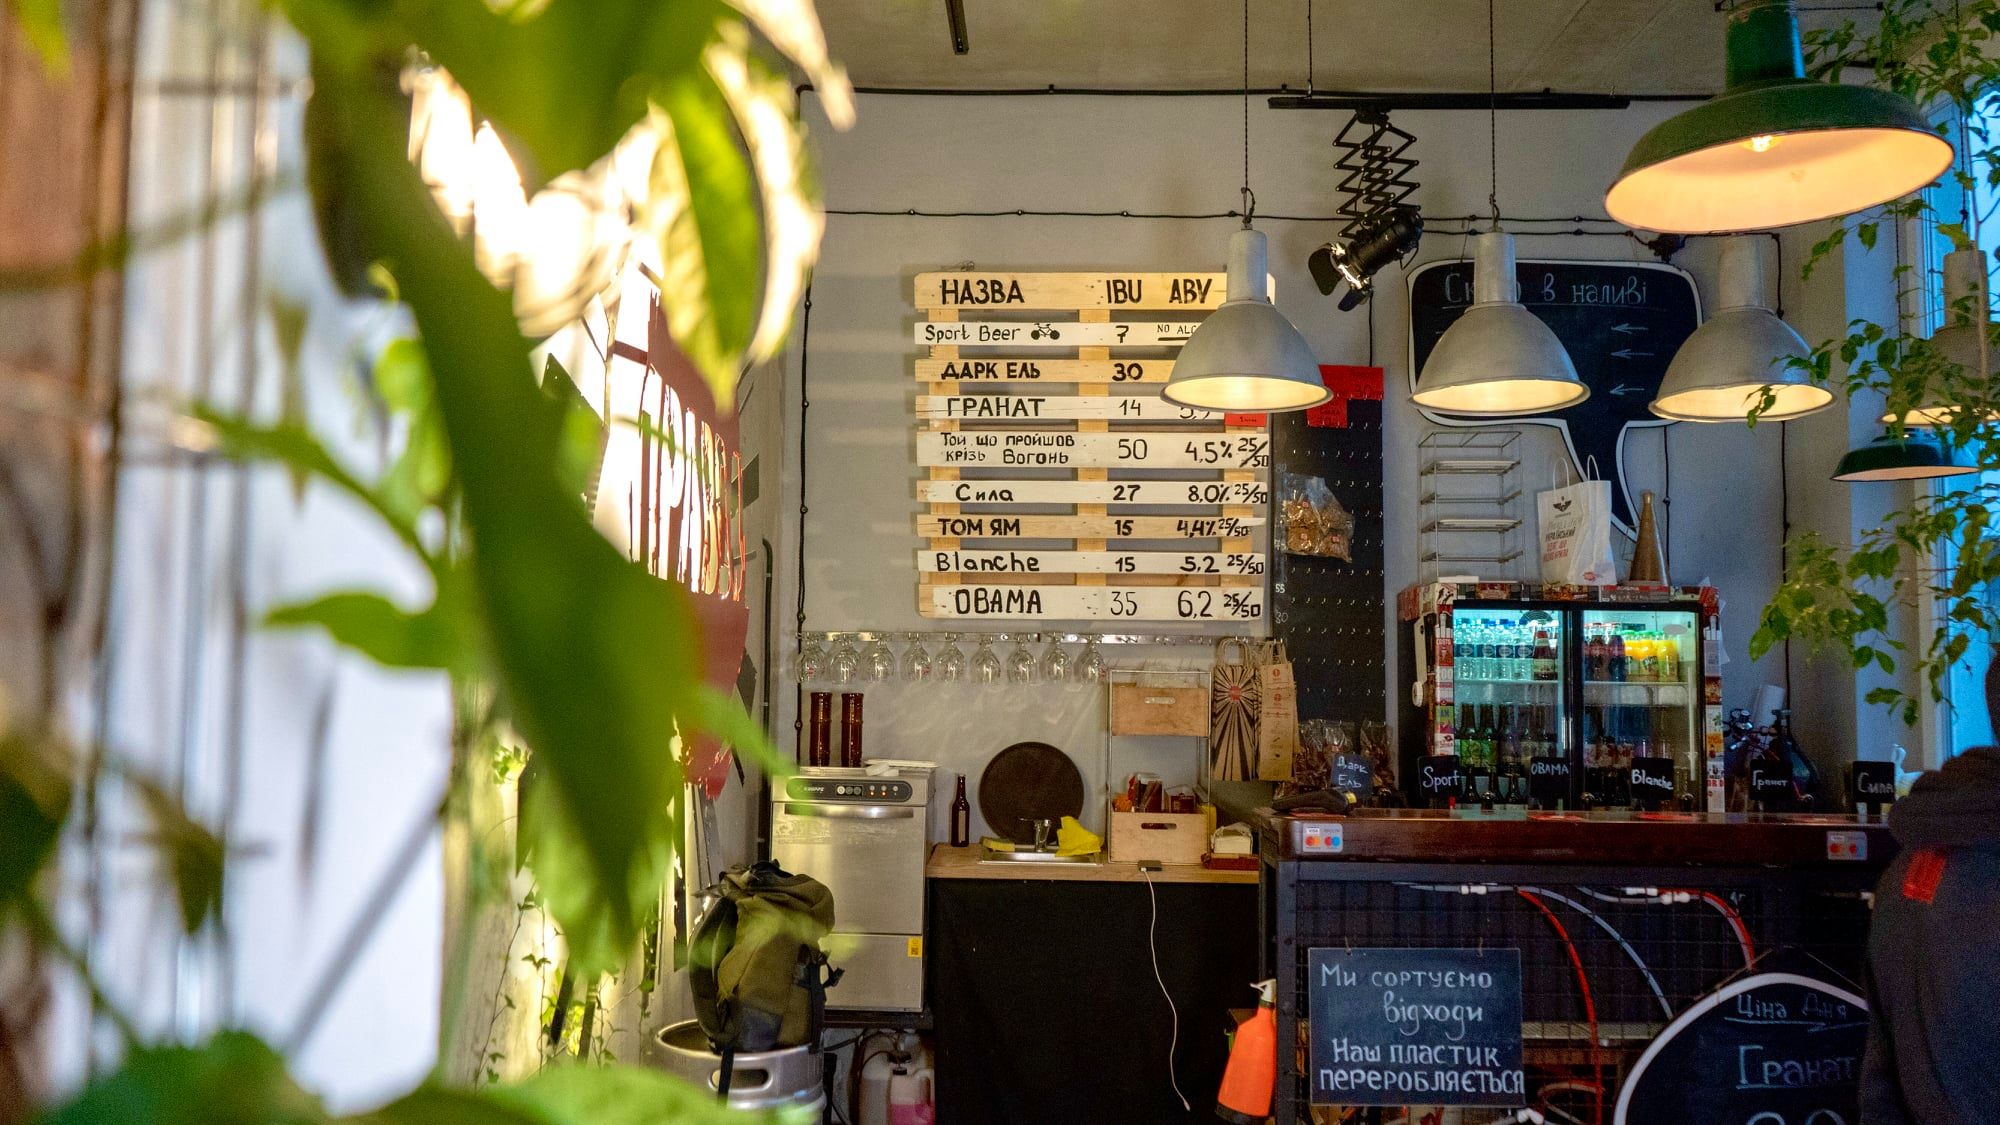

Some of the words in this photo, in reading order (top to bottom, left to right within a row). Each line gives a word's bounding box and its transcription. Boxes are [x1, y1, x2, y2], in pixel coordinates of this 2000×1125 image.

[941, 279, 1025, 305] НАЗВА
[1106, 279, 1142, 304] IBU
[1572, 275, 1647, 304] наливі
[925, 324, 969, 344] Sport
[979, 325, 1021, 342] Beer
[1116, 325, 1130, 344] 7
[1156, 324, 1170, 334] NO
[941, 361, 999, 380] ДАРК
[1006, 362, 1041, 379] ЕЛЬ
[1111, 362, 1143, 381] 30
[946, 397, 1046, 417] ГРАНАТ
[1118, 400, 1142, 416] 14
[1002, 449, 1069, 465] Вогонь
[1117, 439, 1148, 460] 50
[1185, 440, 1233, 464] 4,5%
[1237, 437, 1269, 468] 25/50
[955, 484, 1014, 502] Сила
[1113, 485, 1141, 501] 27
[1188, 483, 1231, 504] 8,0%
[1234, 483, 1268, 504] 25/50
[937, 519, 983, 535] ТОМ
[989, 519, 1020, 535] ЯМ
[1114, 520, 1134, 535] 15
[1176, 519, 1217, 539] 4,4%
[1218, 518, 1250, 538] 25/50
[936, 552, 1040, 572] Blanche
[1115, 556, 1136, 573] 15
[1179, 556, 1220, 574] 5,2
[1226, 554, 1265, 575] 25/50
[954, 588, 1043, 615] OBAMA
[1110, 591, 1138, 616] 35
[1177, 590, 1213, 619] 6,2
[1223, 591, 1262, 619] 25/50
[1422, 765, 1461, 793] Sport
[1531, 762, 1569, 776] OBAMA
[1631, 768, 1674, 791] Blanche
[1321, 963, 1356, 987] Ми
[1383, 990, 1483, 1042] відходи
[1332, 1038, 1380, 1063] Наш
[1389, 1043, 1500, 1067] пластик
[1738, 1045, 1857, 1085] Гранат
[1320, 1068, 1525, 1094] переробляється
